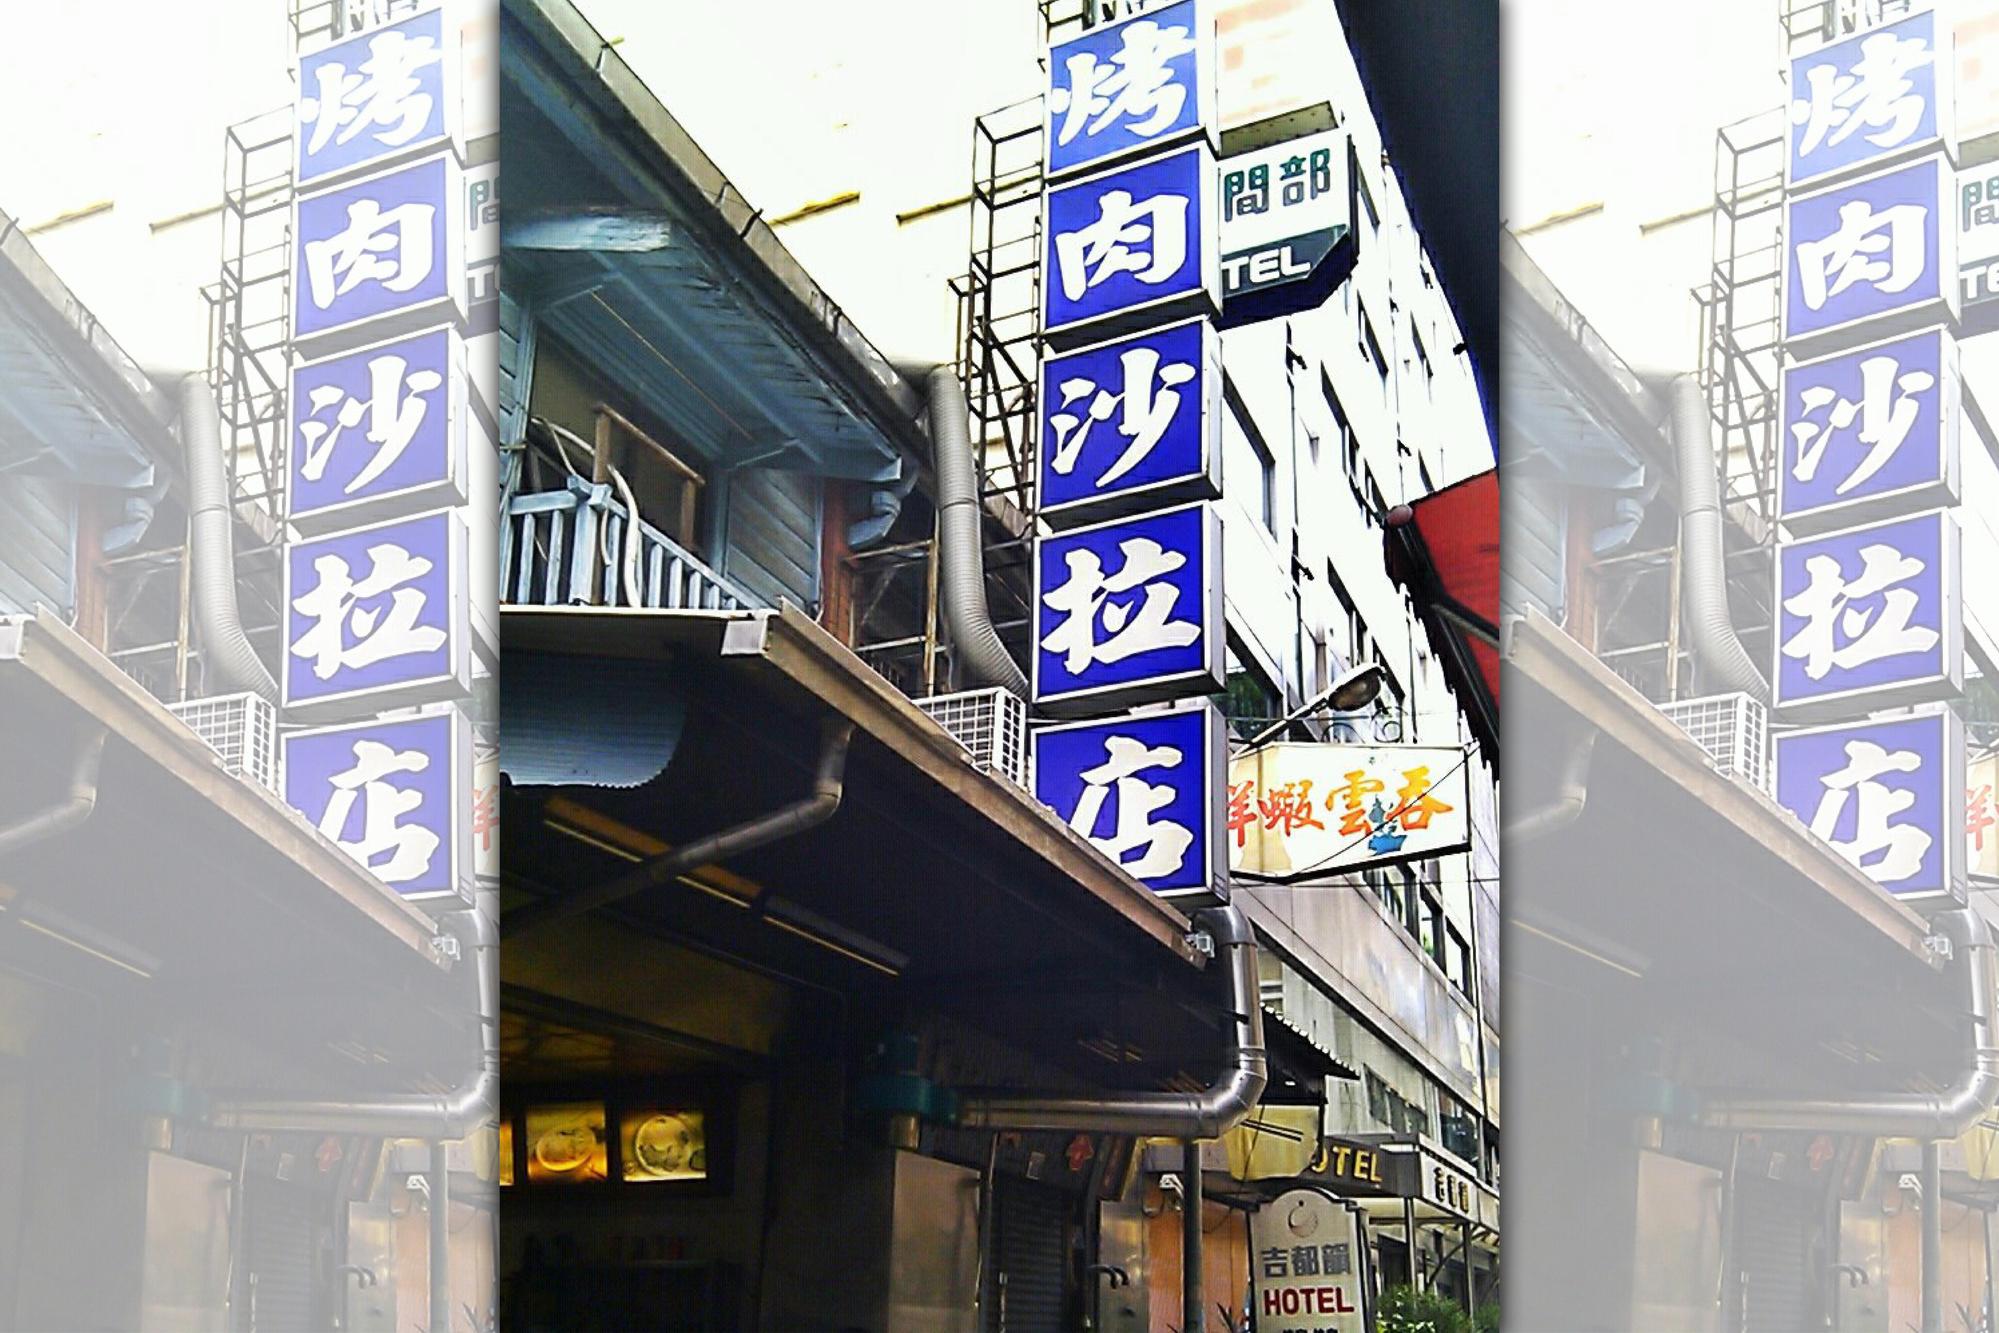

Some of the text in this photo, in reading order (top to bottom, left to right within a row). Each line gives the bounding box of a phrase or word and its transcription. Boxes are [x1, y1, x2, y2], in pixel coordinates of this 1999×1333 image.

[290, 30, 447, 882] 烤肉沙拉店
[1041, 20, 1200, 879] 烤肉沙拉店
[1781, 32, 1940, 882] 烤肉沙拉店
[1263, 1286, 1355, 1316] HOTEL
